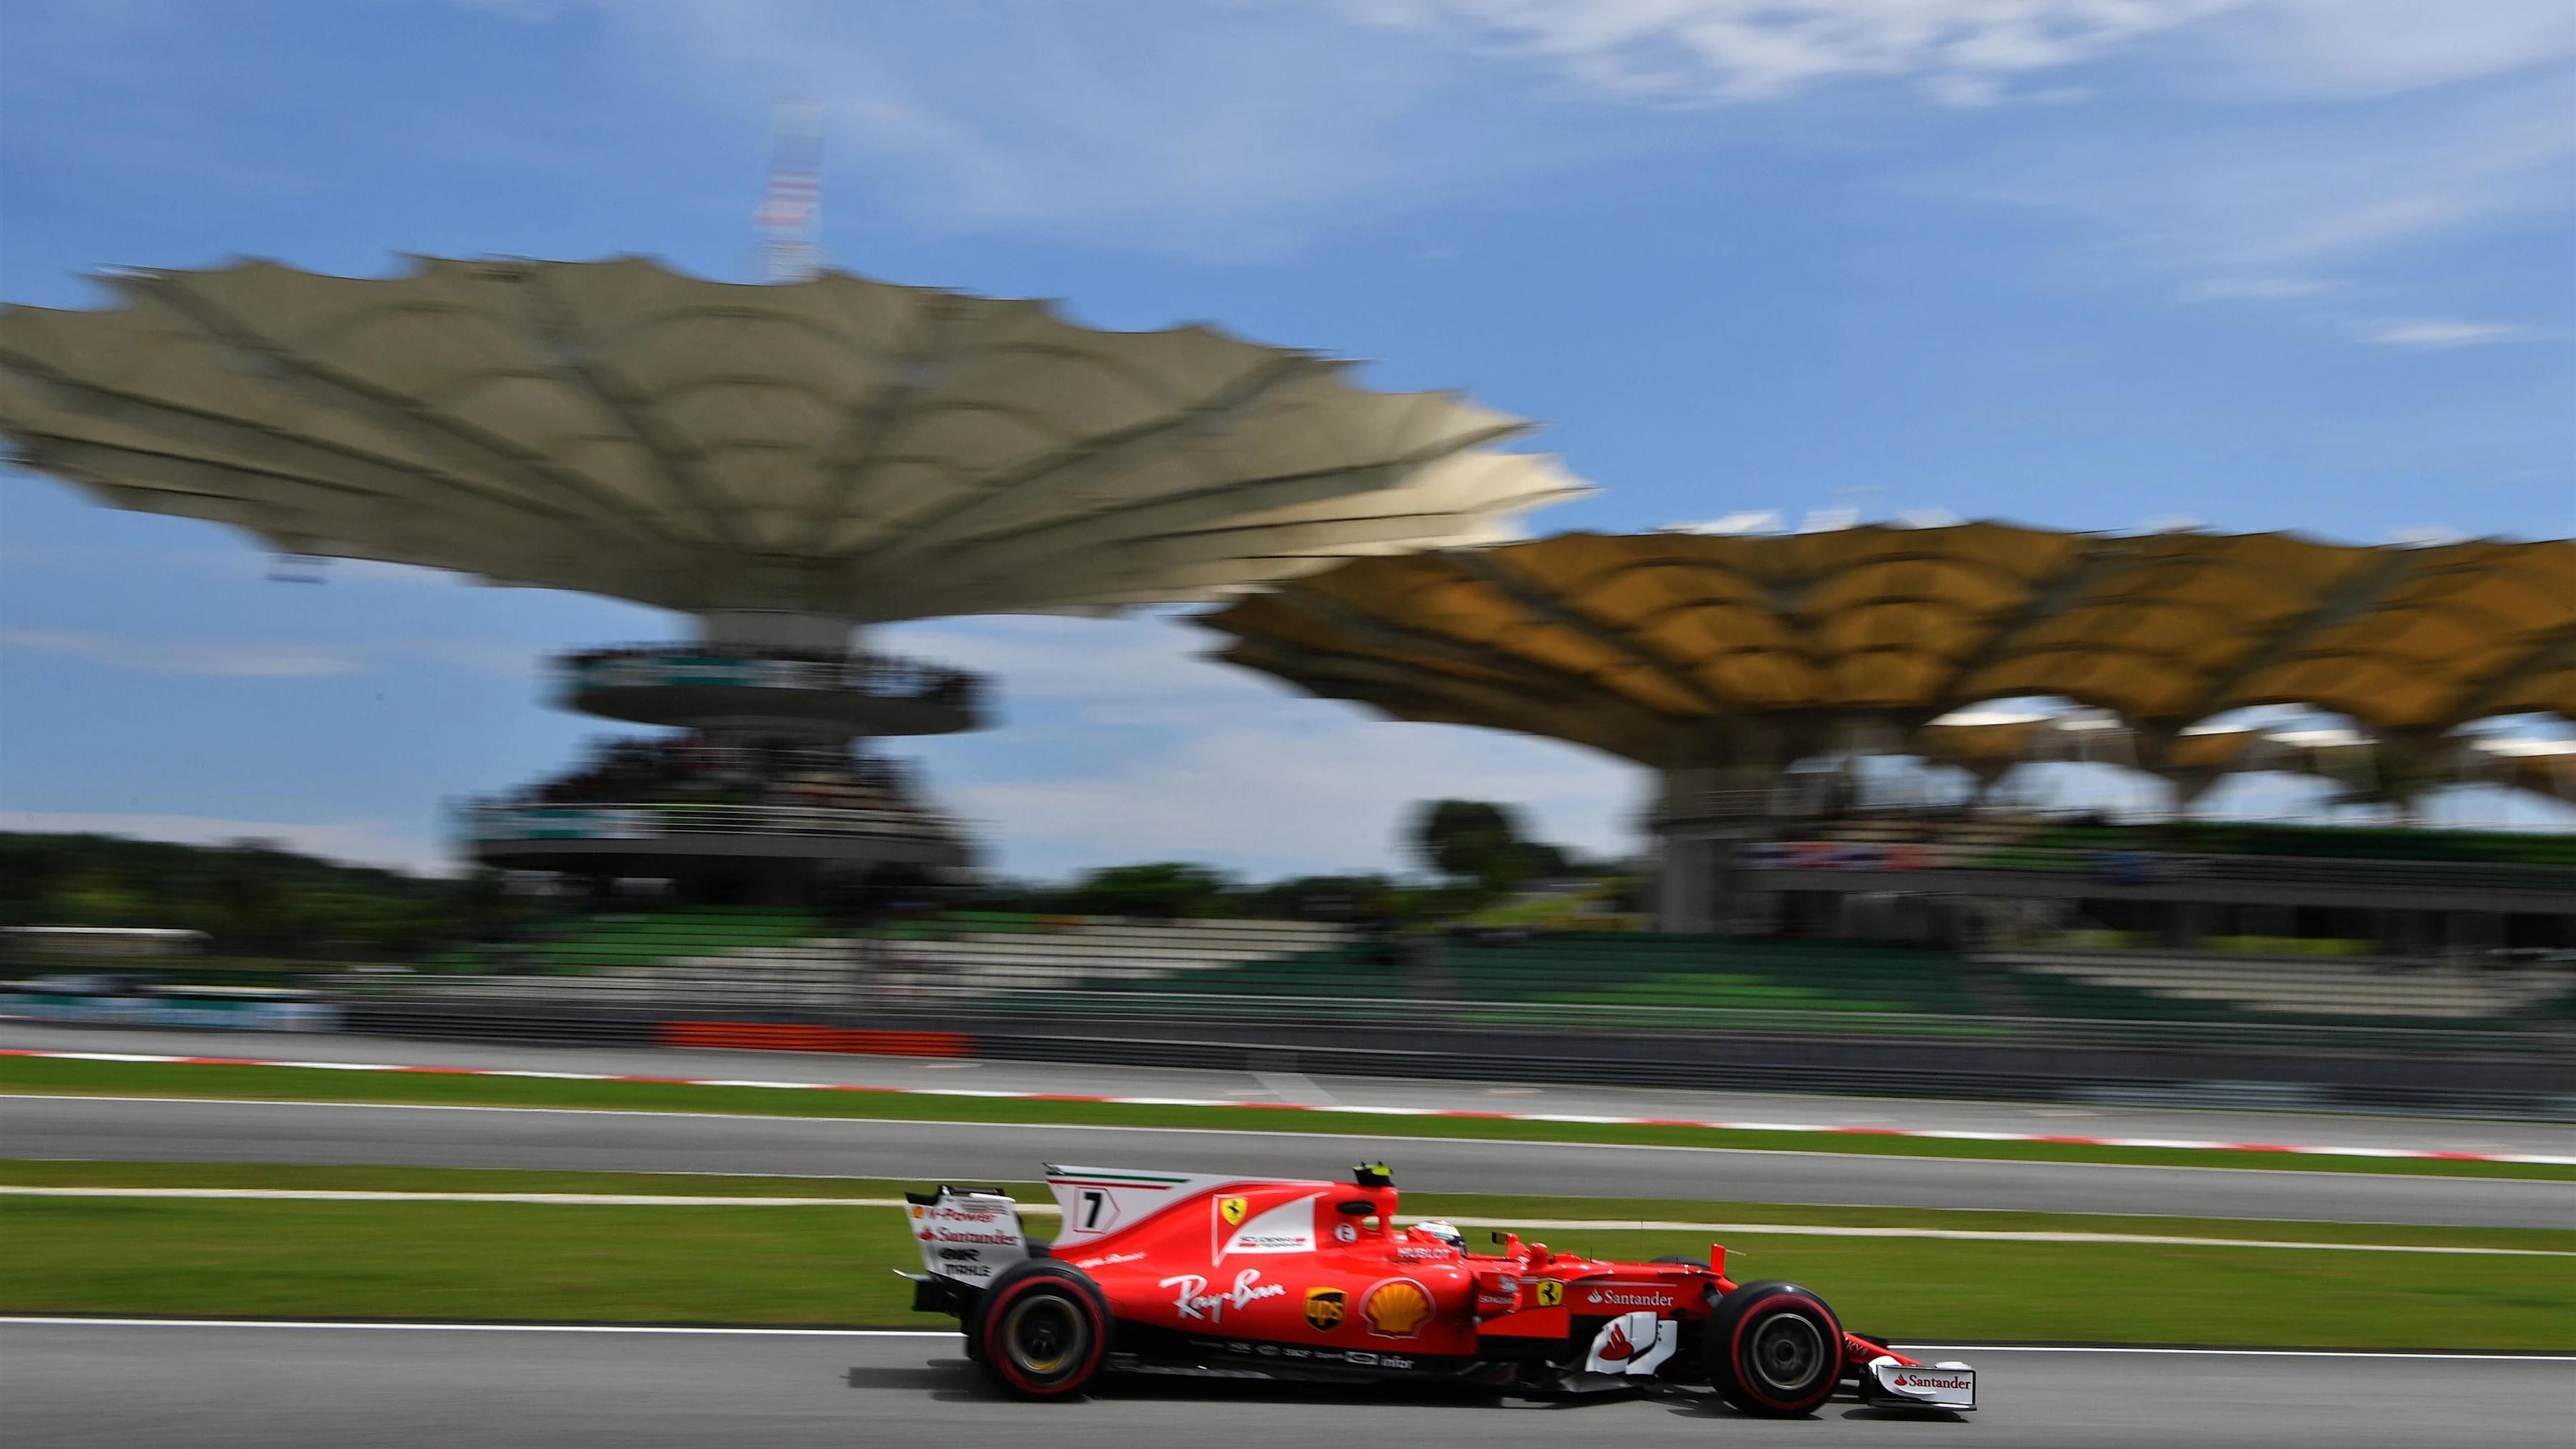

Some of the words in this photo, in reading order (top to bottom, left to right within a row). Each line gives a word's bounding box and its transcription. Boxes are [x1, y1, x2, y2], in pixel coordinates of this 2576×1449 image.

[1084, 1191, 1103, 1228] 7
[935, 1226, 1020, 1246] Santander
[1397, 1247, 1451, 1260] HUBLOT
[1158, 1268, 1287, 1324] Ray-Ban
[1604, 1288, 1674, 1307] Santander
[1909, 1374, 1971, 1390] Santander
